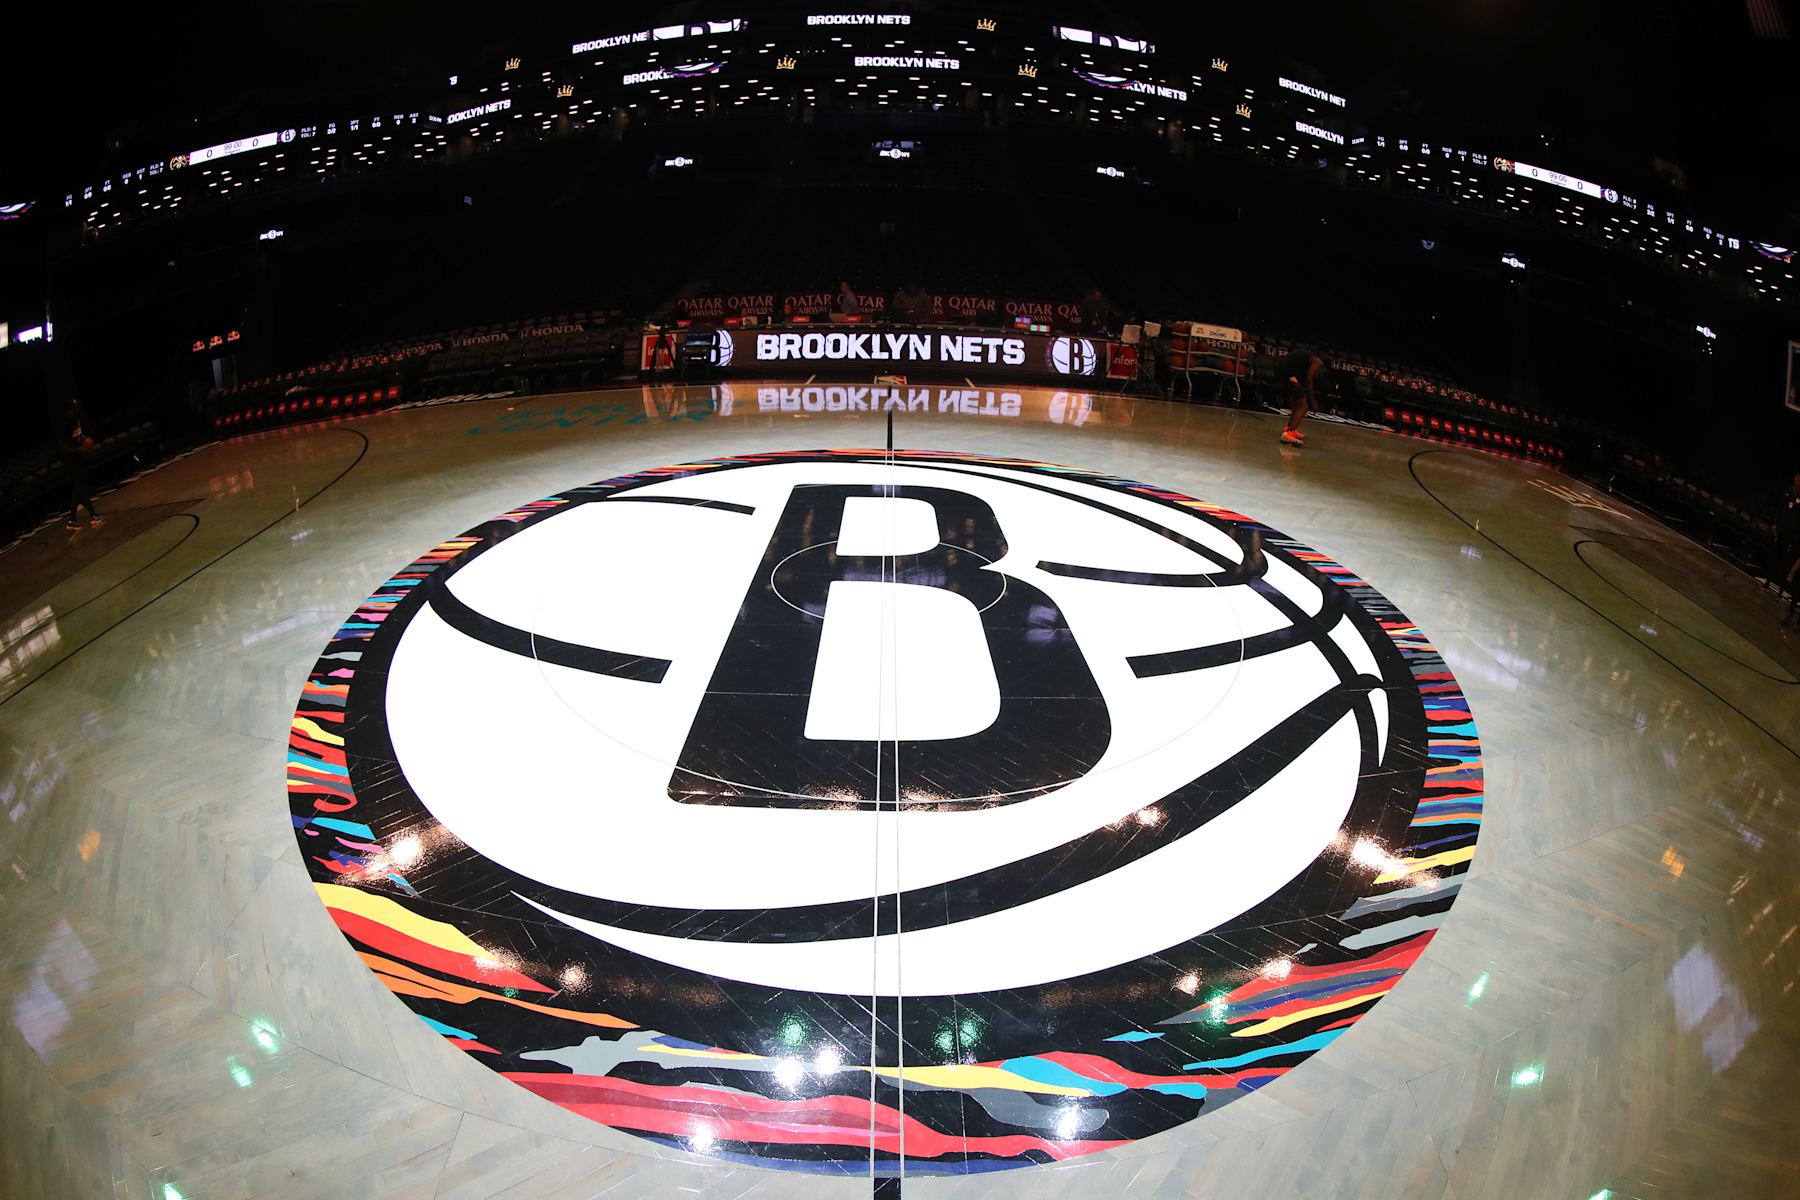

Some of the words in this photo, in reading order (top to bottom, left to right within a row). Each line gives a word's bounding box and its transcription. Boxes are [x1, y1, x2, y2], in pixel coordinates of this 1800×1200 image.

[807, 15, 874, 25] BROOKLYN
[877, 15, 911, 25] NETS
[572, 34, 631, 54] BROOKLYN
[854, 56, 923, 68] BROOKLYN
[925, 58, 960, 69] NETS
[1157, 86, 1187, 101] NETS
[1279, 77, 1328, 101] BROOKLYN
[1329, 94, 1346, 107] NET
[447, 107, 484, 124] OOKLYN
[485, 99, 511, 113] NETS
[1296, 121, 1344, 145] BROOKLYN
[206, 149, 213, 158] 0
[252, 138, 259, 147] 0
[1532, 168, 1538, 177] 0
[1577, 181, 1583, 190] 0
[728, 296, 774, 309] QATAR
[949, 296, 996, 310] QATAR
[1006, 302, 1052, 316] QATAR
[532, 324, 584, 337] HONDA
[463, 333, 509, 346] HONDA
[756, 332, 932, 361] BROOKLYN
[940, 335, 1025, 365] NETS
